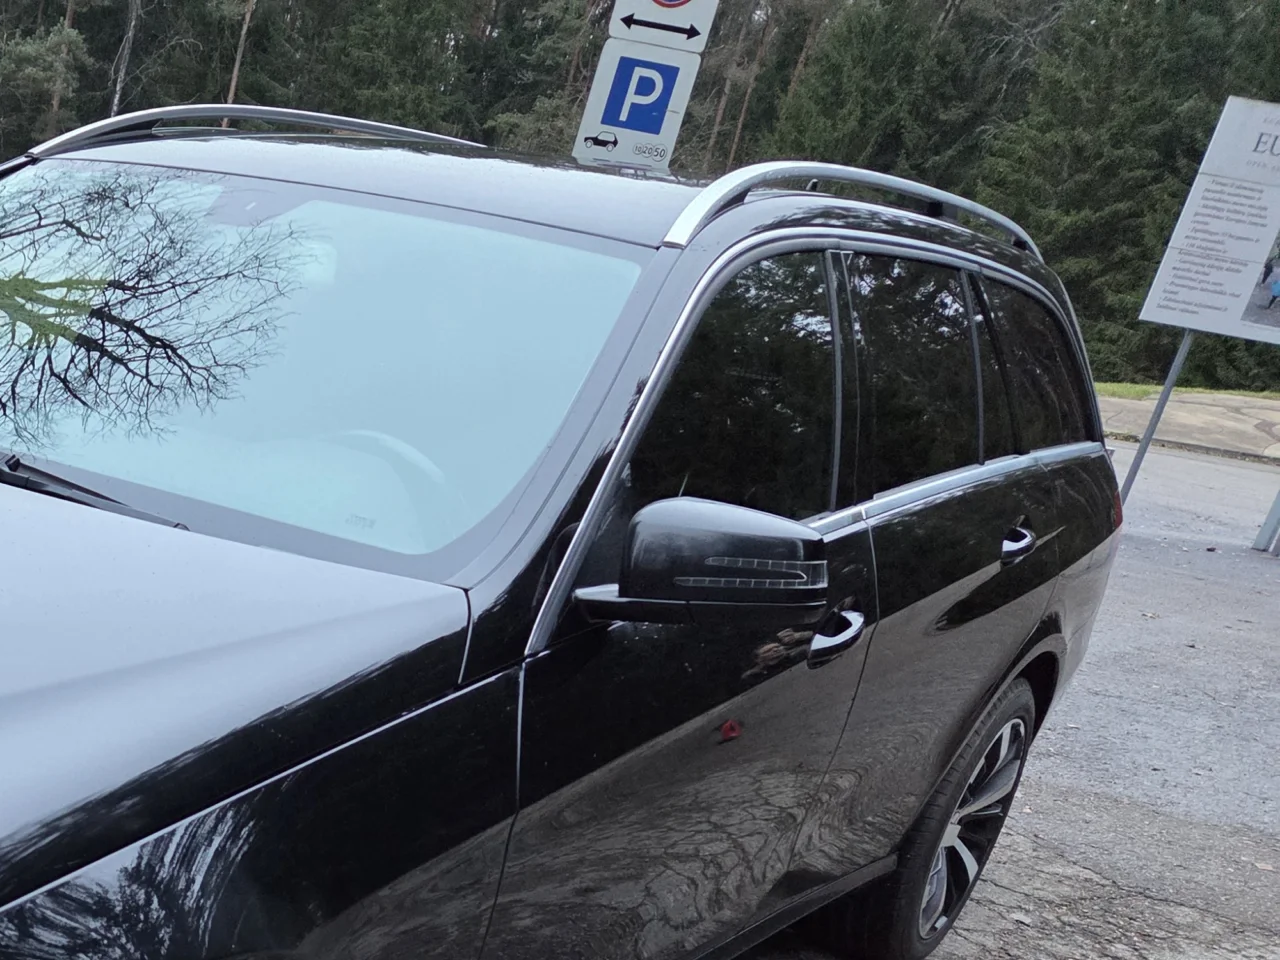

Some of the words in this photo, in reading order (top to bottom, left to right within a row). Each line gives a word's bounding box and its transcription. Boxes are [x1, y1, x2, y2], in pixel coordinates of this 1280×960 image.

[619, 66, 664, 122] P
[643, 145, 653, 155] 20
[653, 147, 666, 158] 50
